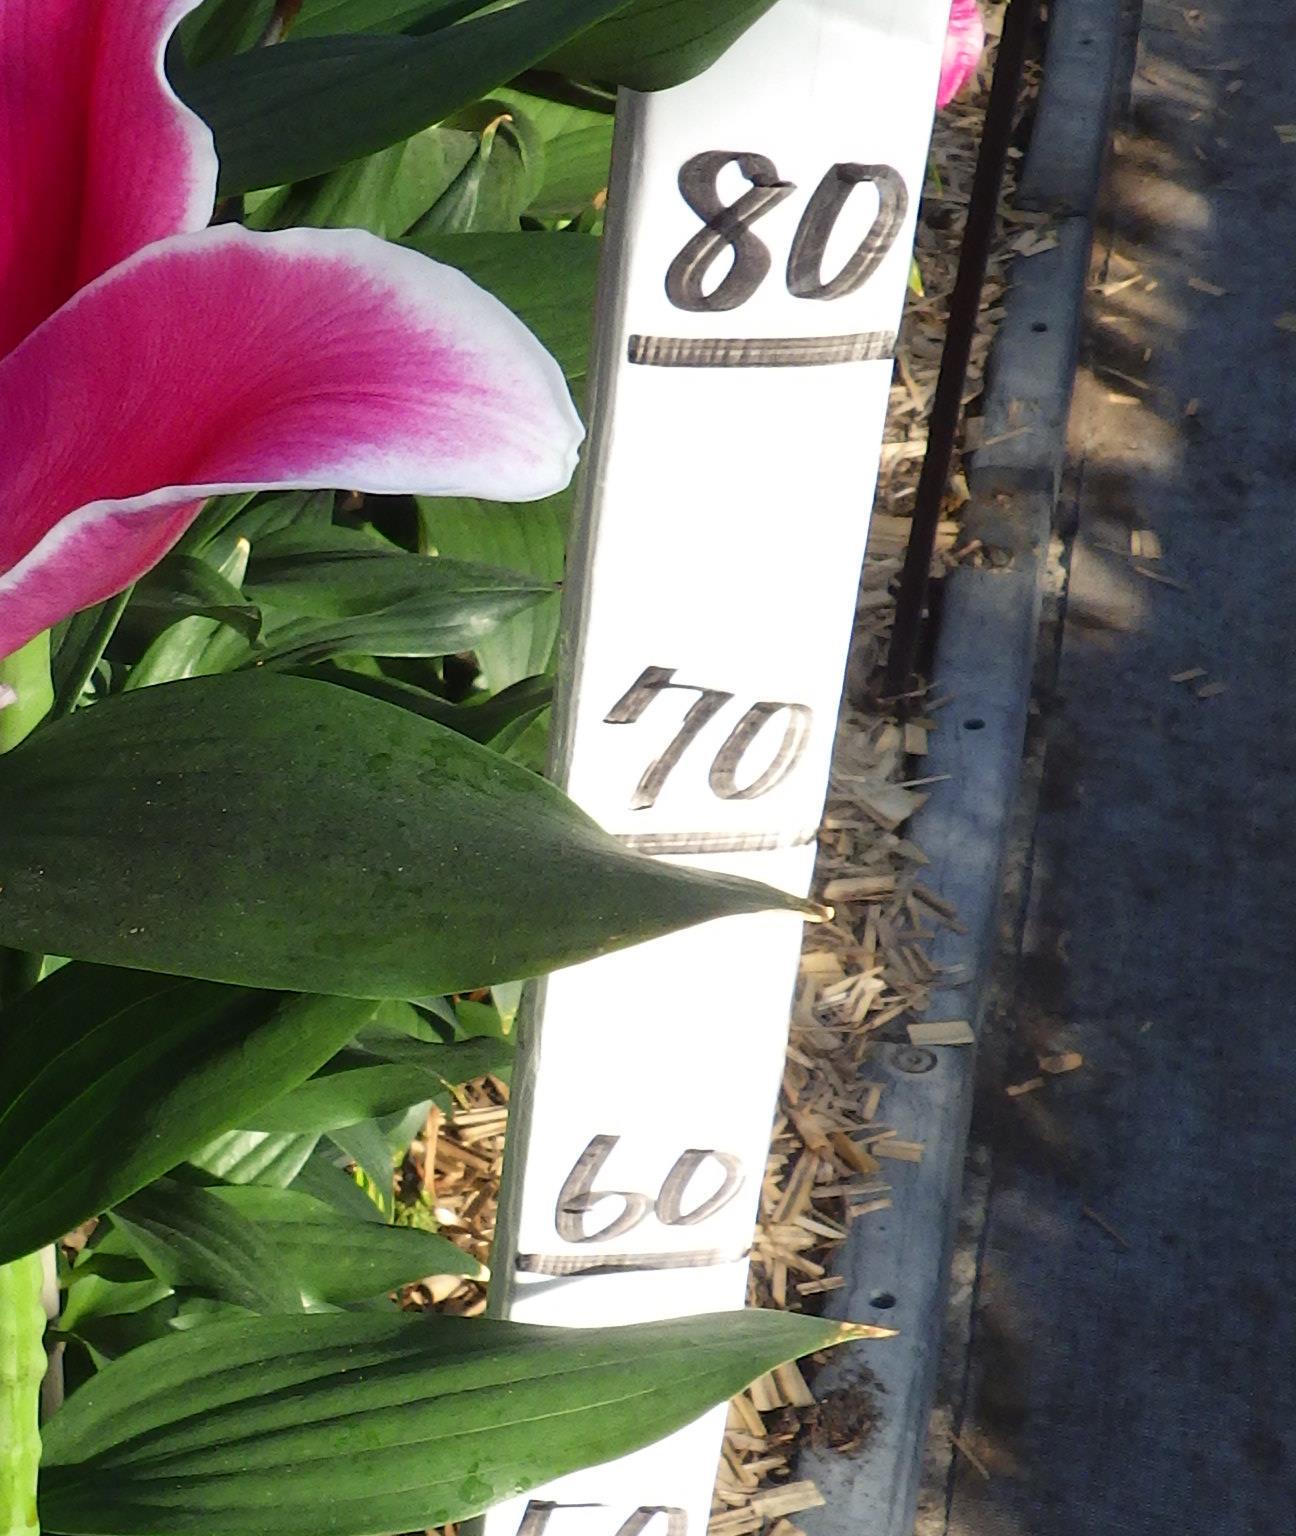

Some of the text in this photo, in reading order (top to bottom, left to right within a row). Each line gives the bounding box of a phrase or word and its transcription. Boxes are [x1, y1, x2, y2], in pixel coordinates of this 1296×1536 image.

[664, 149, 908, 313] 80
[602, 665, 814, 811] 70
[553, 1133, 745, 1244] 60
